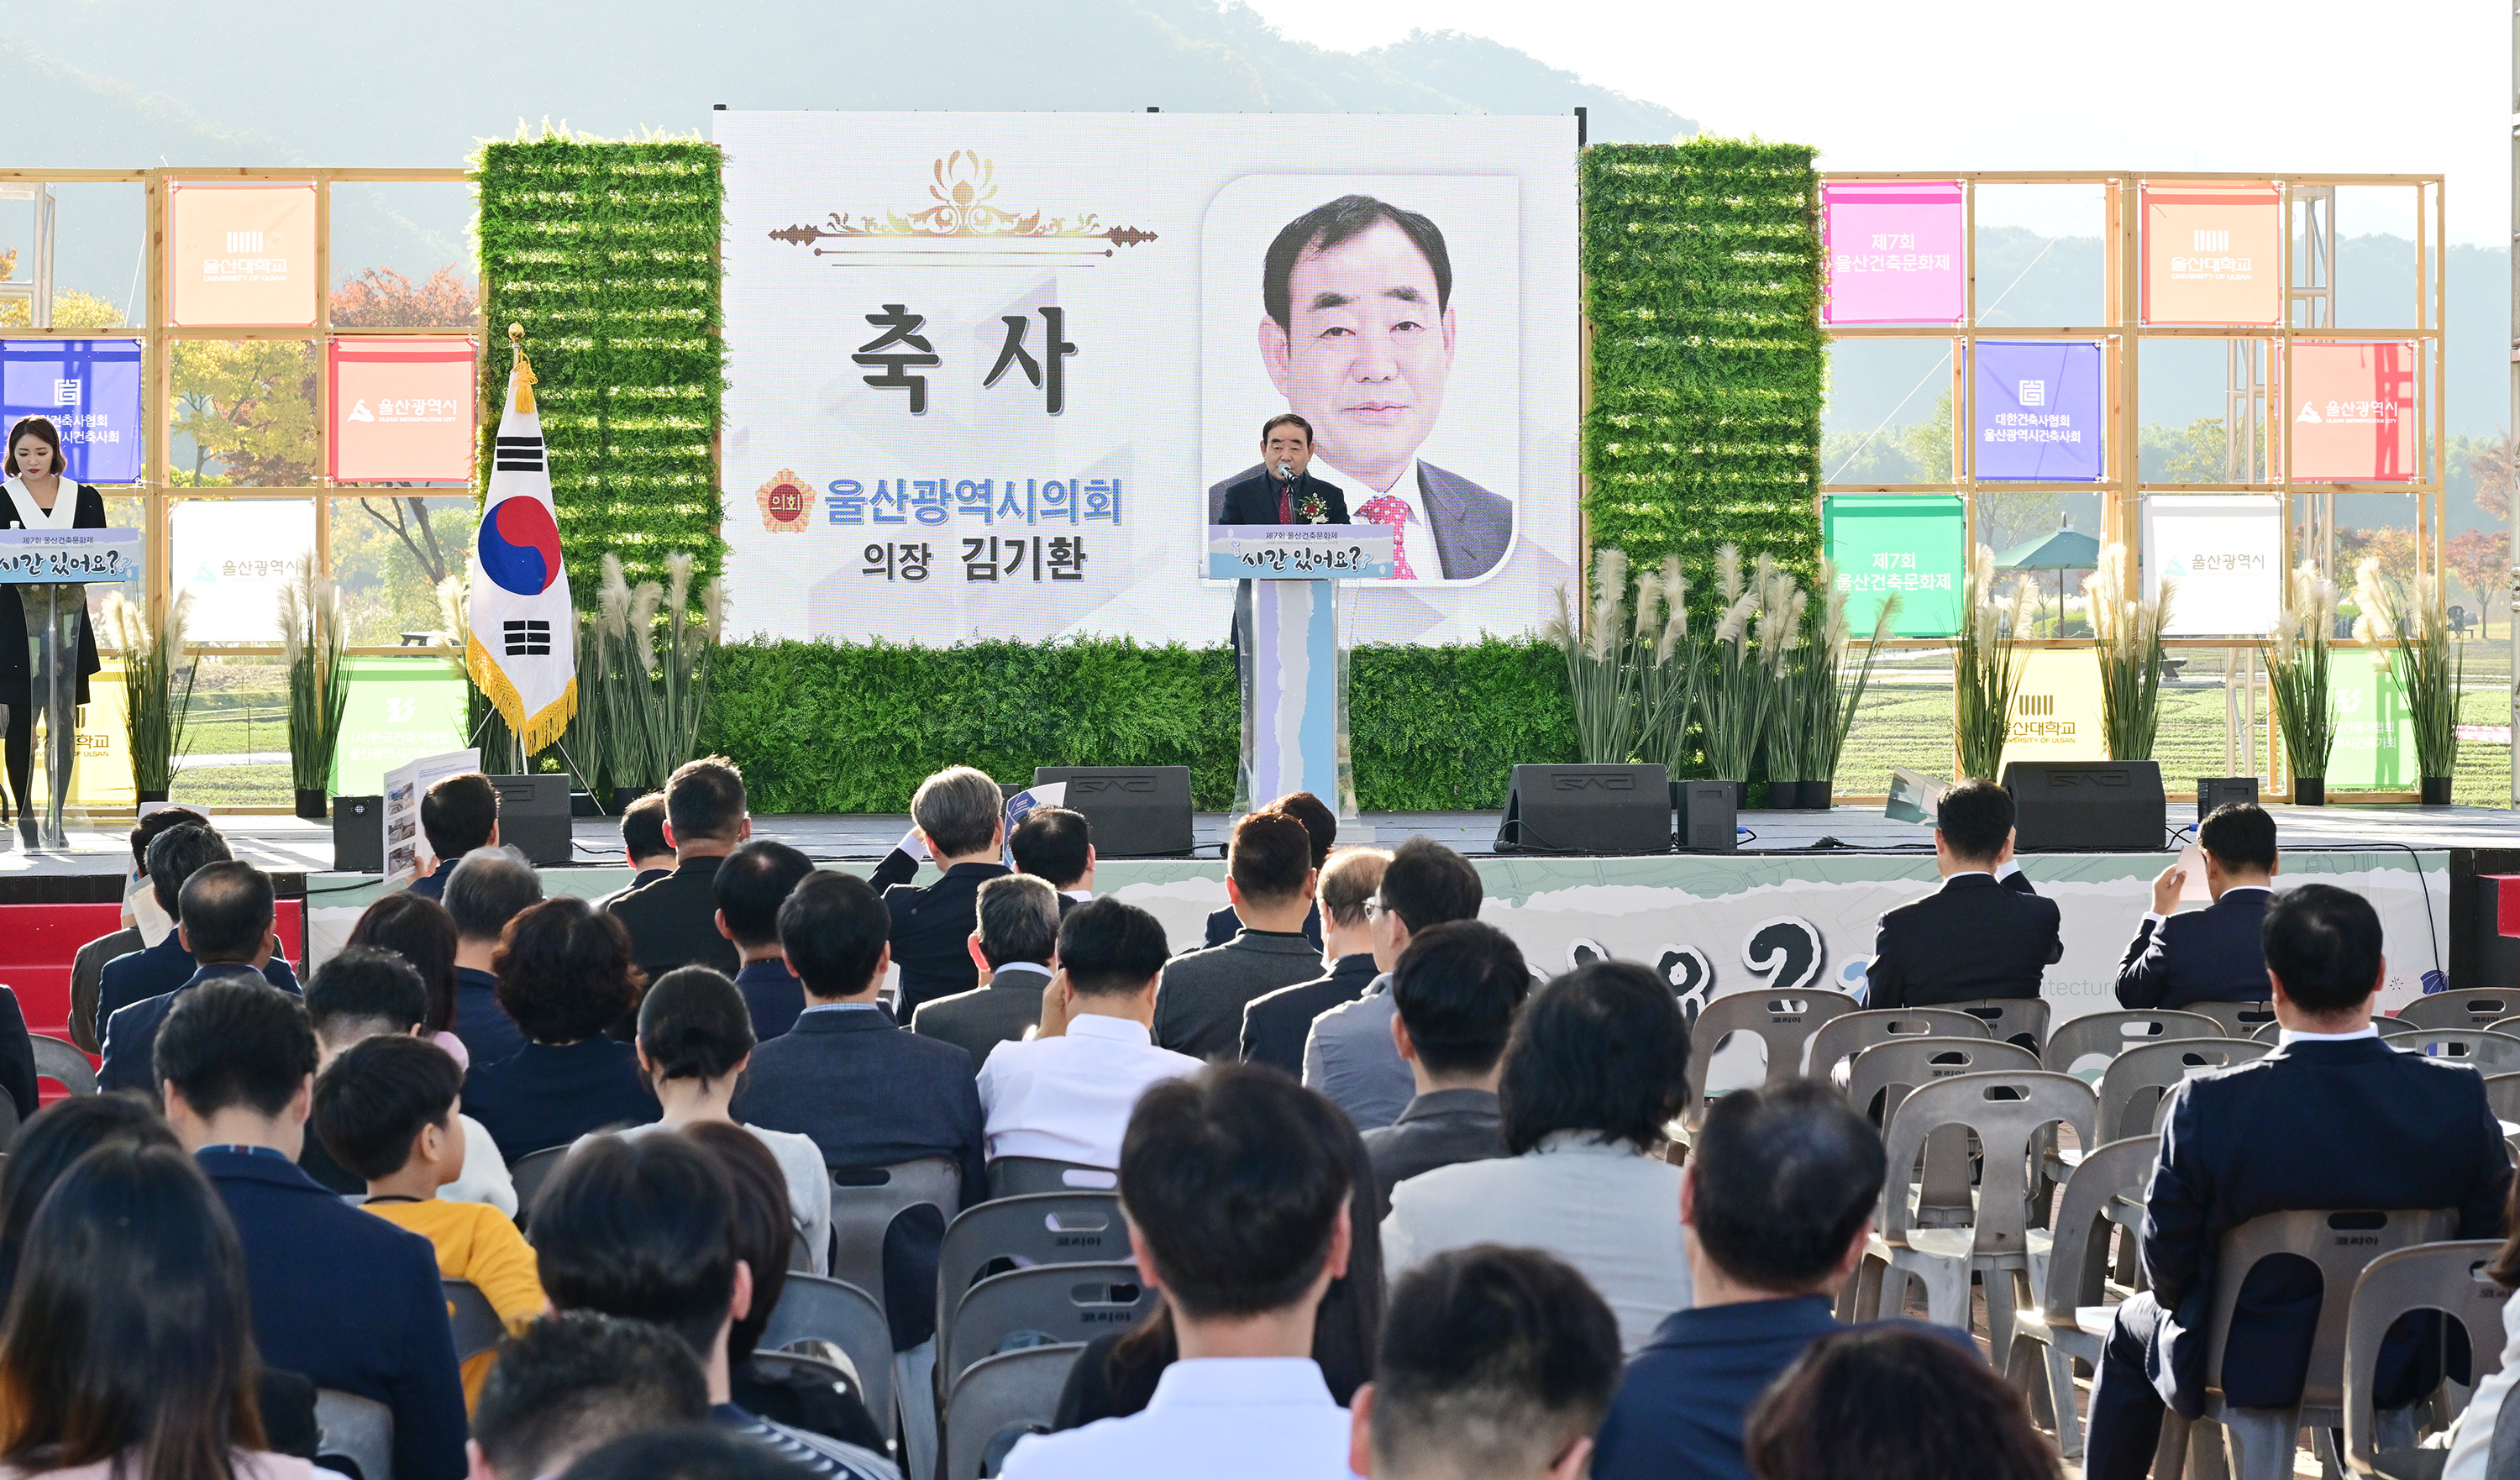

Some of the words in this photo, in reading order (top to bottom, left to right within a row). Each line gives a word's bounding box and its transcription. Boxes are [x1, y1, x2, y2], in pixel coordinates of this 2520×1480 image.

[1871, 233, 1915, 250] 제7회
[202, 257, 288, 274] 울산대학교
[1835, 254, 1950, 273] 울산건축문화제
[2170, 256, 2252, 272] 울산대학교
[377, 398, 458, 416] 울산광역시
[2324, 401, 2398, 417] 울산광역시
[1995, 412, 2071, 428] 대한건축사협회
[1983, 428, 2082, 443] 울산광역시건축사회
[768, 493, 802, 512] 의회
[824, 477, 1122, 525] 울산광역시의회
[44, 536, 94, 544] 울산건축문화제
[1265, 532, 1285, 540] 제7회
[1287, 531, 1338, 540] 울산건축문화제
[862, 542, 932, 581] 의장
[961, 535, 1087, 582] 김기환
[1242, 548, 1288, 571] 시간
[1294, 546, 1362, 572] 있어요?
[1872, 552, 1916, 570] 제7회
[2192, 554, 2265, 570] 울산광역시
[222, 559, 298, 576] 울산광역시
[1836, 573, 1951, 591] 울산건축문화제
